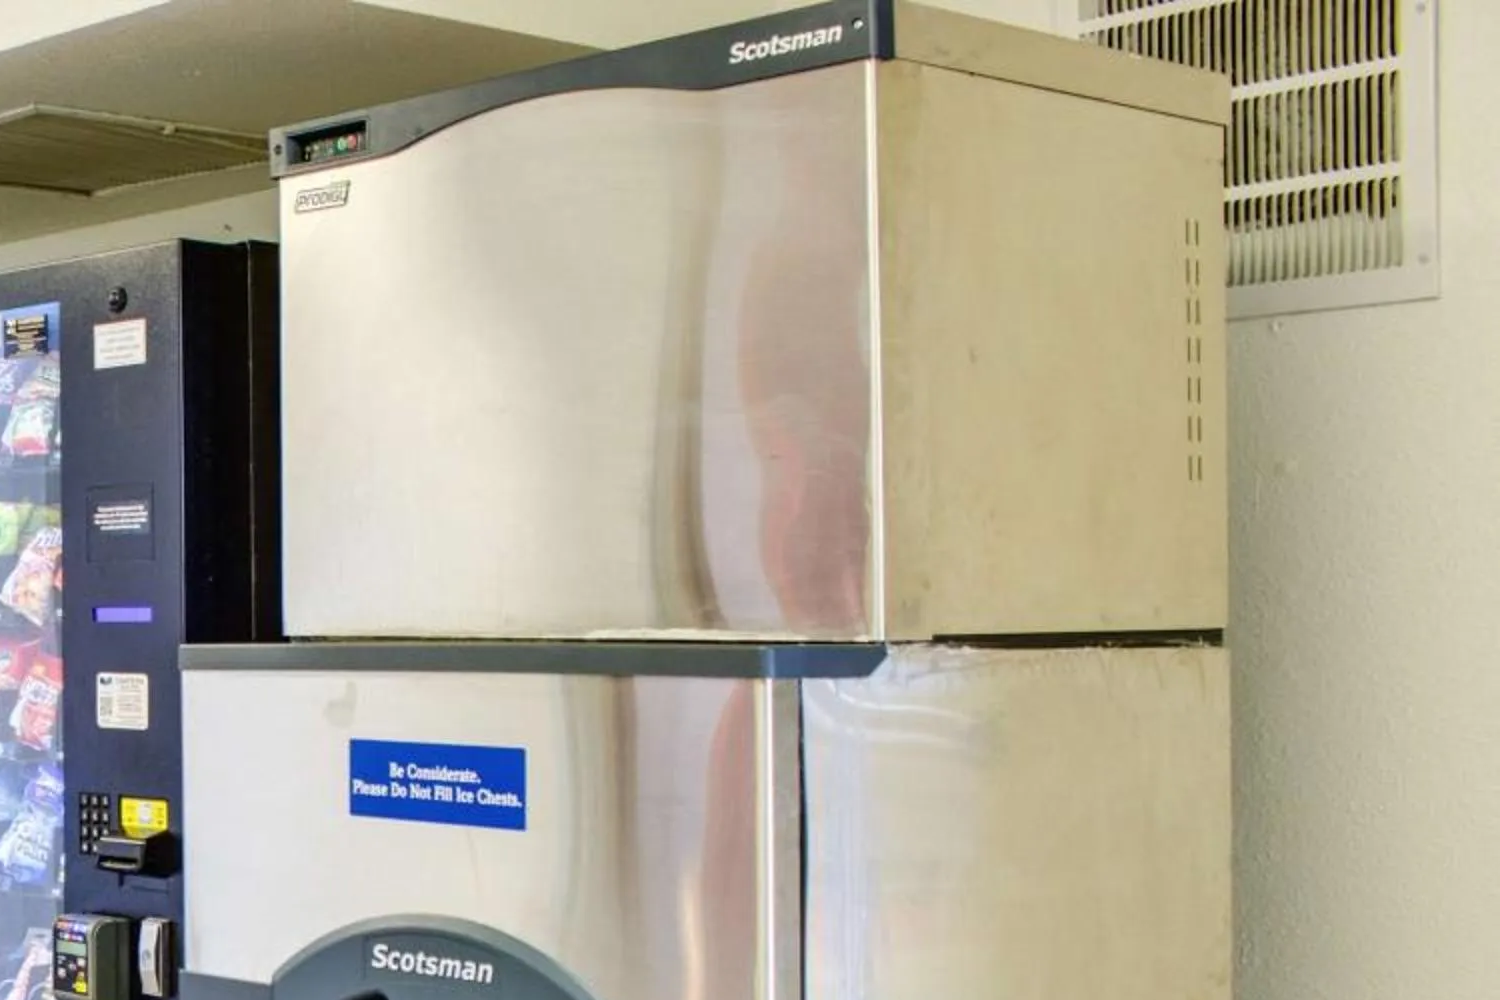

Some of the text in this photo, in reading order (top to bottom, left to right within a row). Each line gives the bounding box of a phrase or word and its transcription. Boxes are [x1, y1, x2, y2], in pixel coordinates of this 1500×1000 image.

[728, 24, 843, 64] Scotsman
[389, 761, 481, 784] Be Considerate.
[352, 778, 522, 808] Please Do Not Fill Ice Chests.
[370, 943, 494, 984] Scotsman
